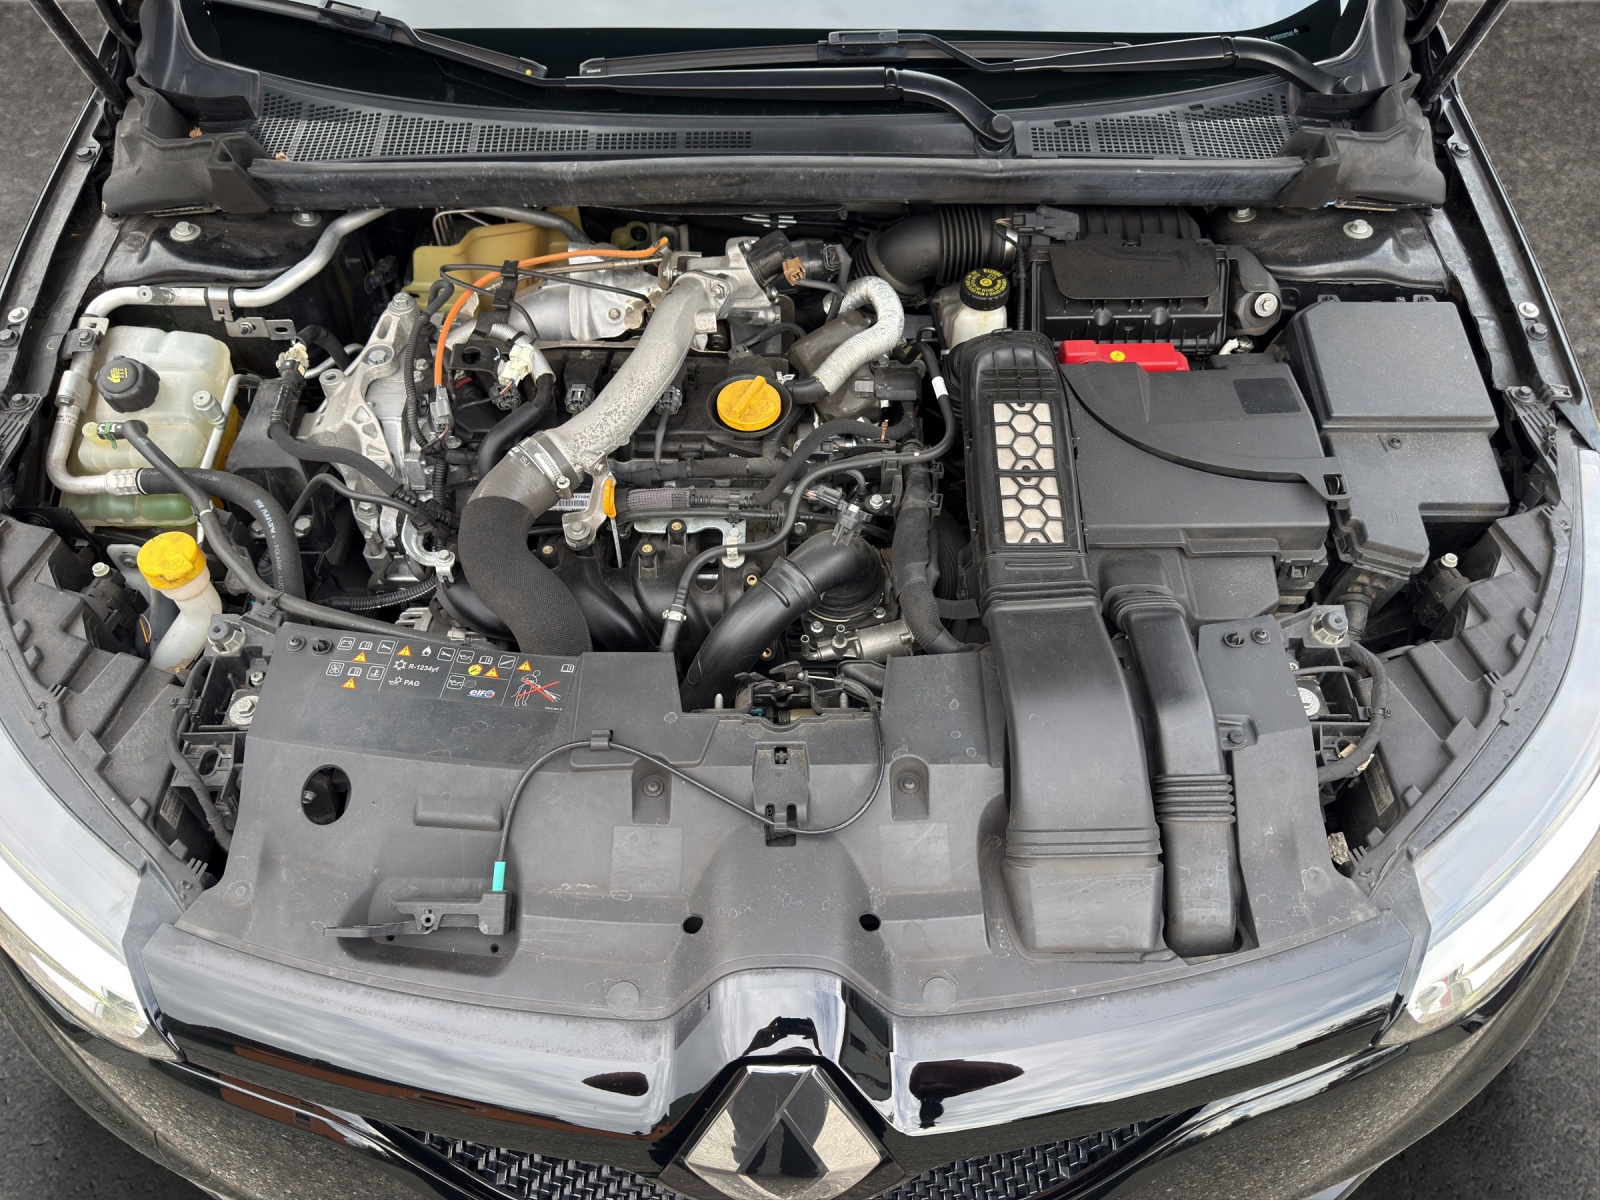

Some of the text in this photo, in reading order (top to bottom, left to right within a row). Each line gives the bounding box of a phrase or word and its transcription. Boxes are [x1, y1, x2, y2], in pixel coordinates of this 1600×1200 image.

[408, 663, 440, 673] R-1234yf
[404, 679, 421, 687] PAG
[469, 689, 488, 697] elf
